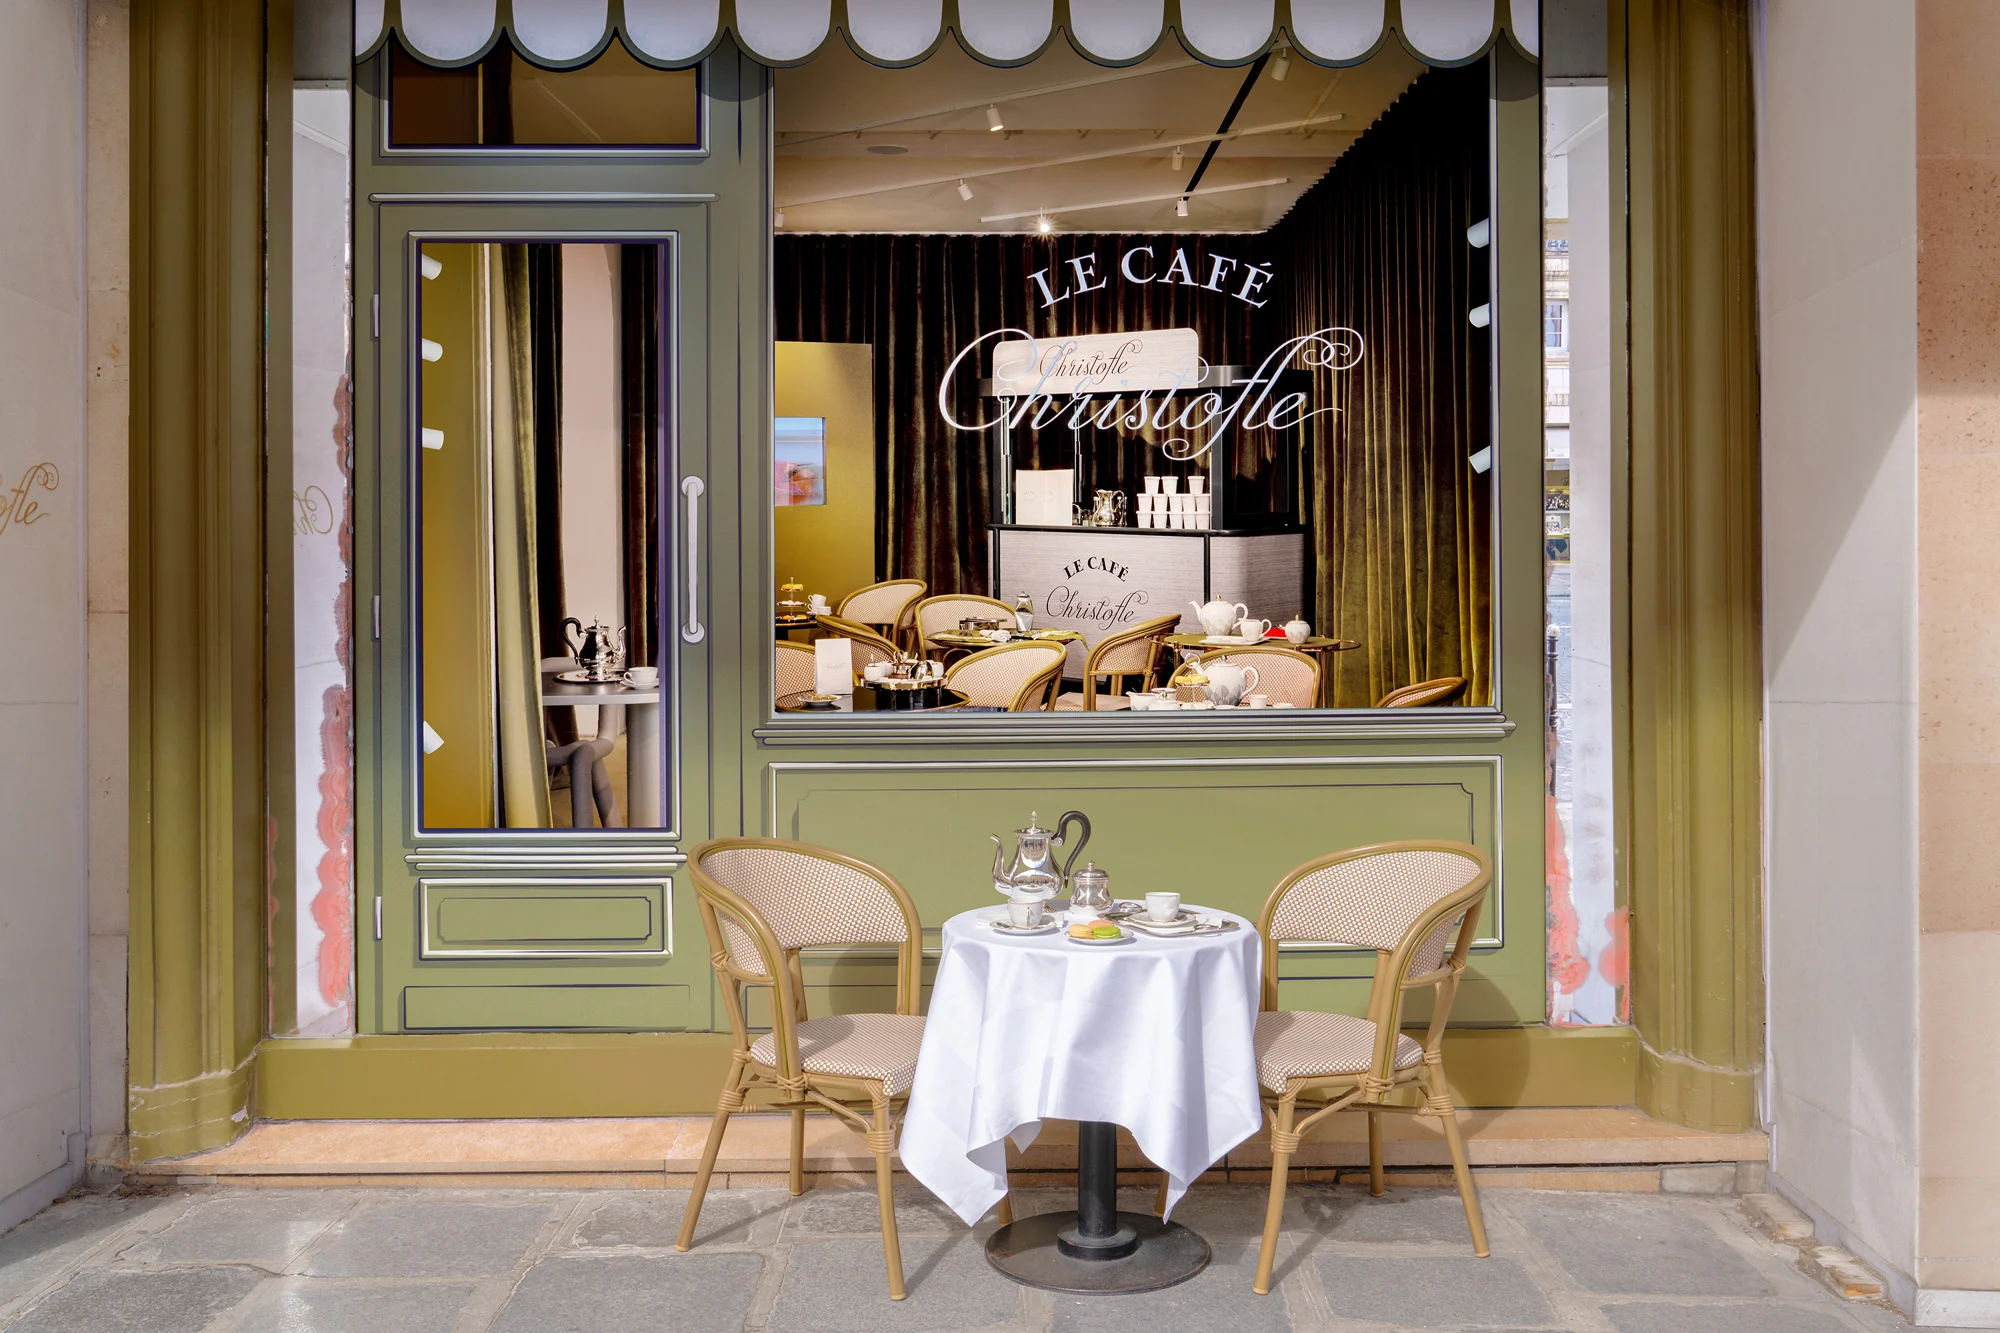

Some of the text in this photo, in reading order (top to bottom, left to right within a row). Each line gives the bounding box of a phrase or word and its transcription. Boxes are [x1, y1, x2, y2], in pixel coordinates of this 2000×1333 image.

[1026, 245, 1274, 309] LE CAFÉ
[1039, 338, 1144, 386] Christofle
[938, 327, 1365, 462] Christofle
[1062, 555, 1130, 583] LE CAFÉ
[1045, 585, 1150, 631] Christofle
